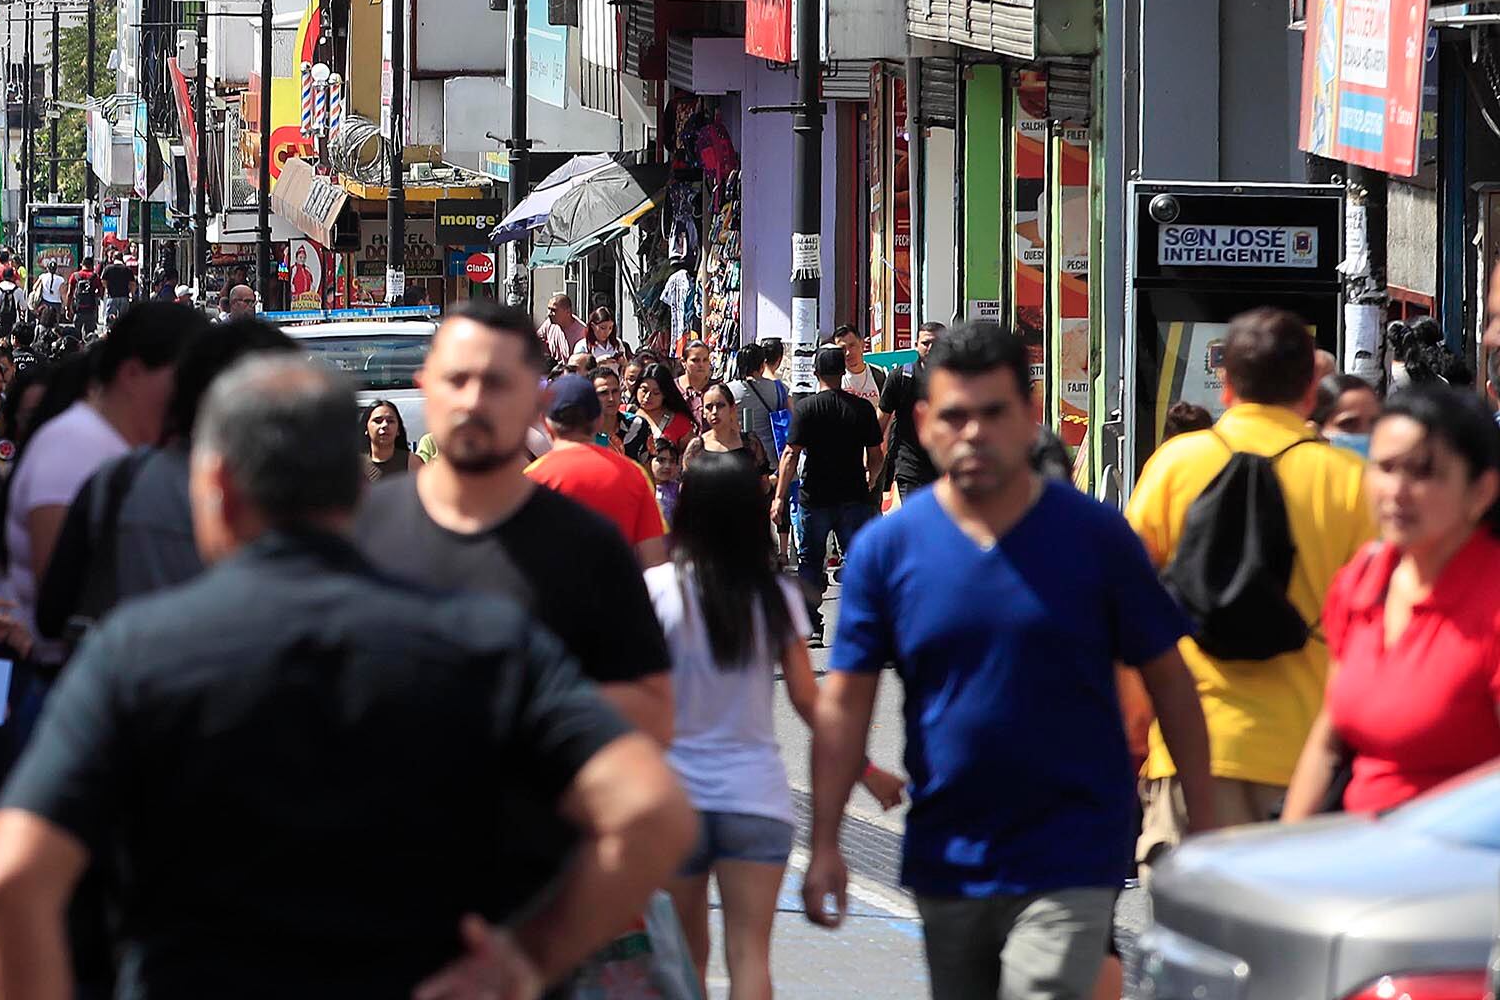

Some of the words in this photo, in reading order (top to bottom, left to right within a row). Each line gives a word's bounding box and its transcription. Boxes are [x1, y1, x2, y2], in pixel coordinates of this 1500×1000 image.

[440, 214, 496, 229] monge
[1165, 228, 1216, 247] S@N
[1221, 226, 1286, 248] JOSÉ
[1164, 248, 1285, 263] INTELIGENTE
[466, 264, 489, 273] Claro
